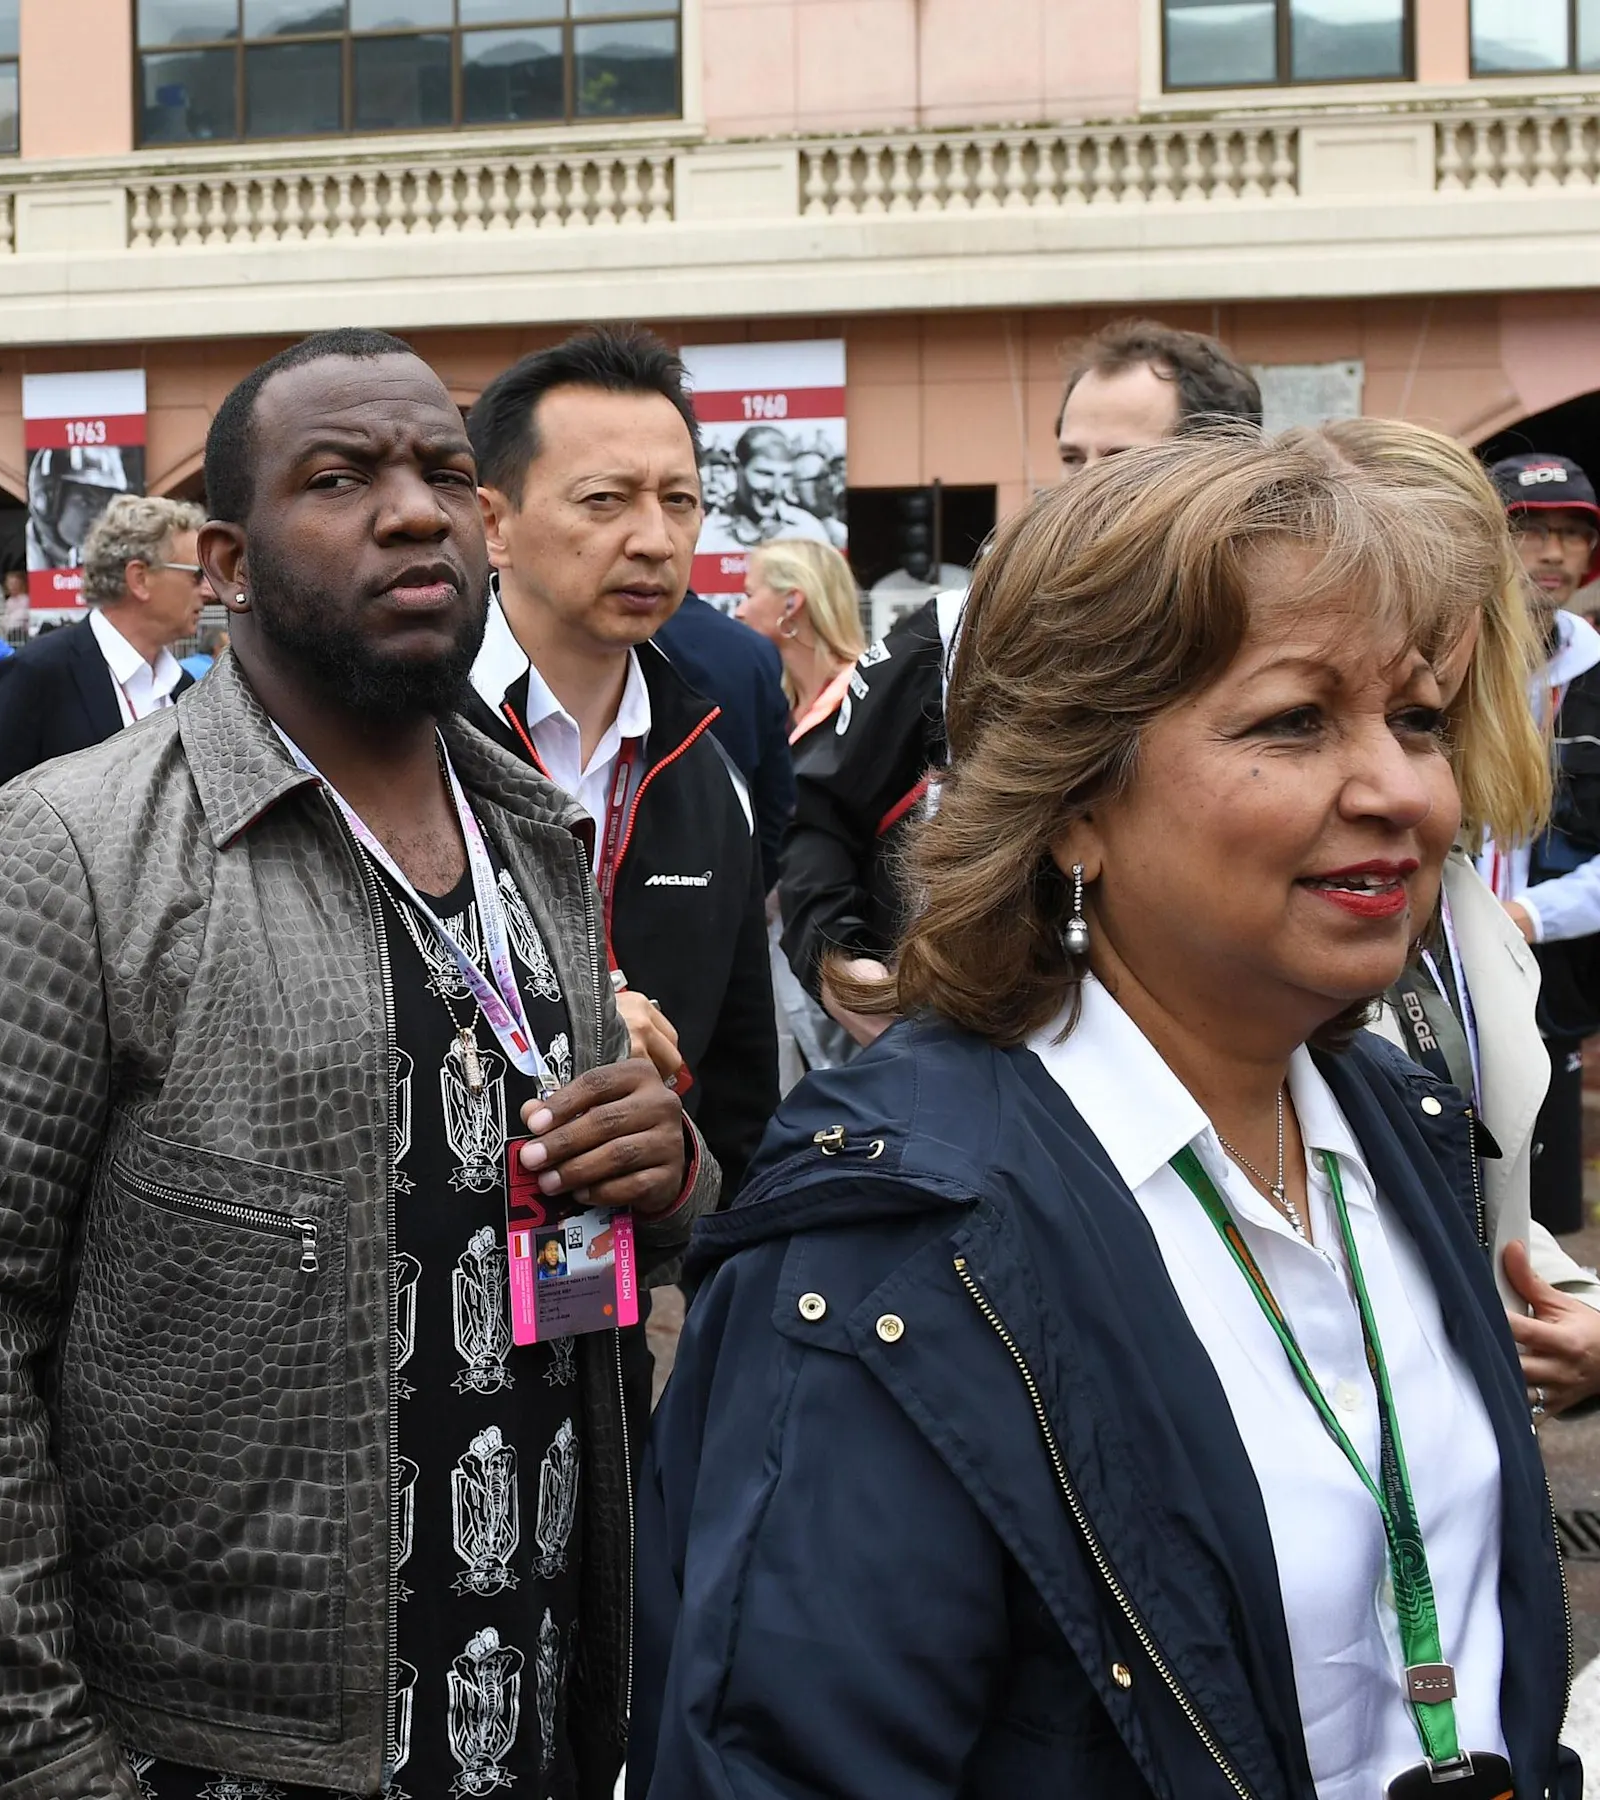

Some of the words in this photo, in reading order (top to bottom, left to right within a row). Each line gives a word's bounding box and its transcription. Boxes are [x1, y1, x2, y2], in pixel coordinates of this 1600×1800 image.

[741, 394, 788, 419] 1960
[65, 421, 106, 444] 1963
[1518, 467, 1568, 486] EOS
[644, 873, 708, 887] McLaren
[476, 983, 510, 1029] VIP
[1401, 991, 1437, 1053] EDGE
[620, 1239, 631, 1300] MONACO
